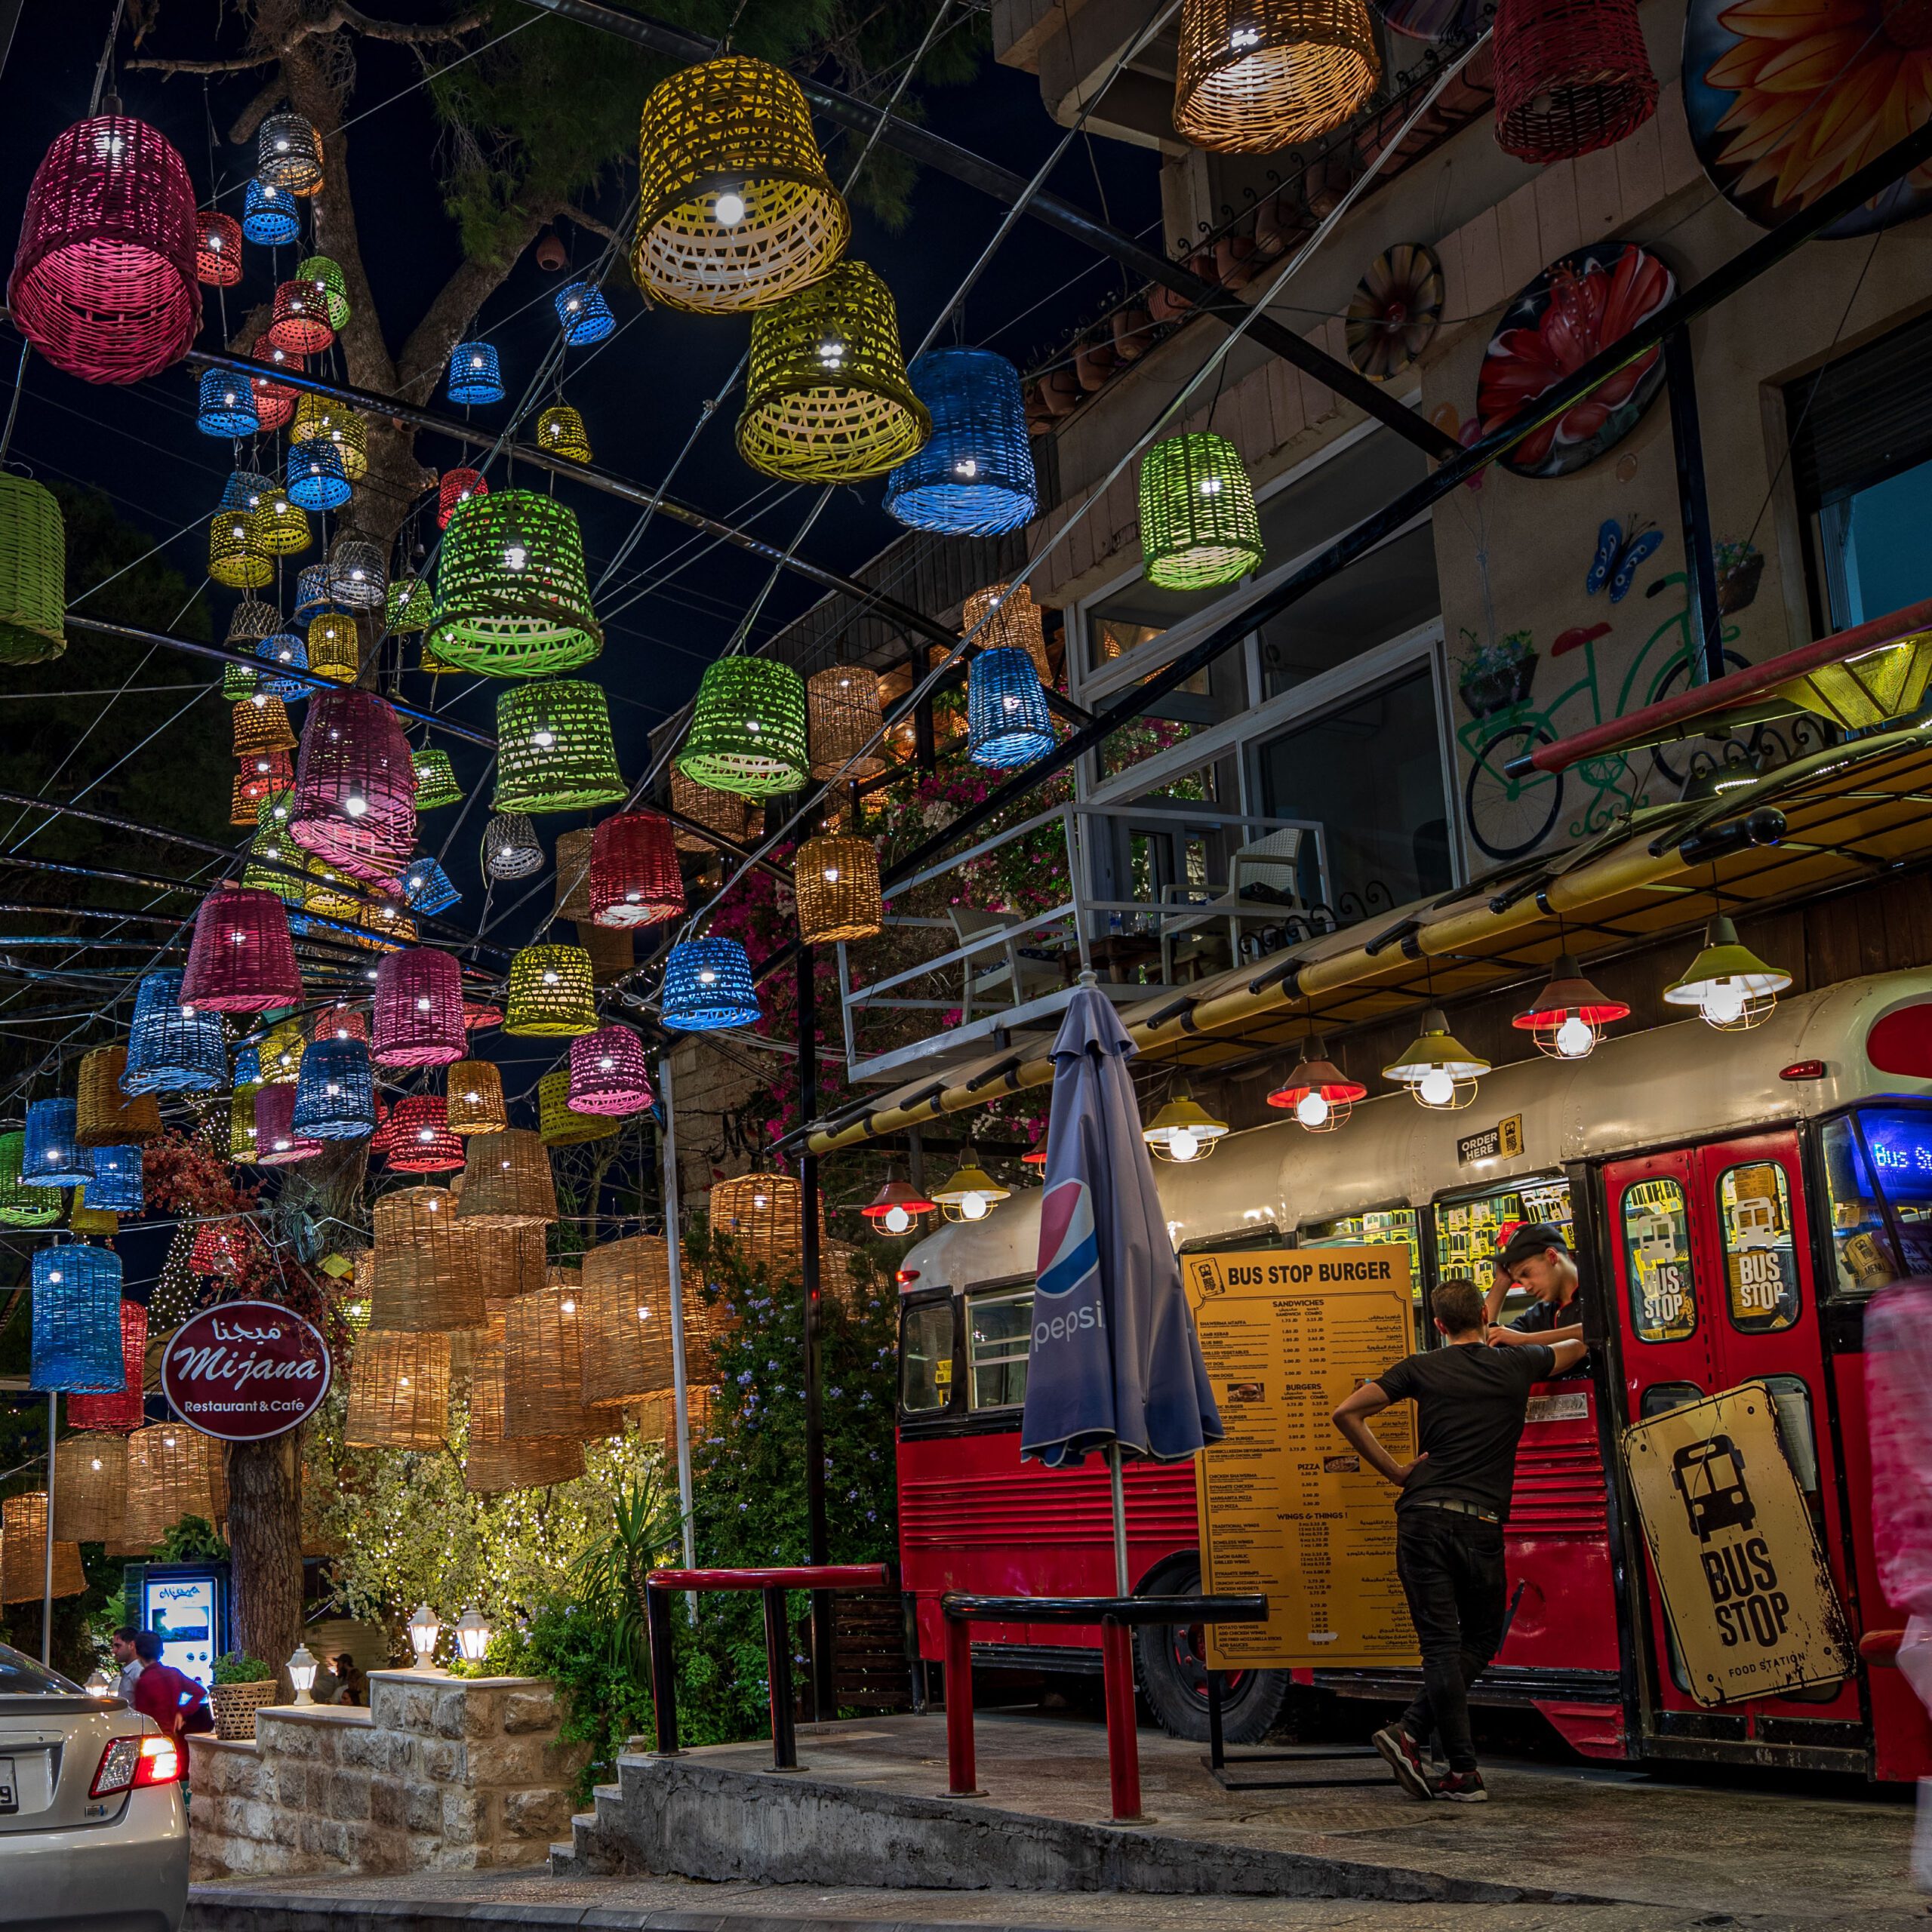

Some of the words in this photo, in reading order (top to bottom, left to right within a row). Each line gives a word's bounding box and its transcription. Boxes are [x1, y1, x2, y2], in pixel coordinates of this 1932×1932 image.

[1462, 1132, 1498, 1152] ORDER
[1466, 1143, 1494, 1160] HERE
[1874, 1143, 1909, 1167] Bus
[1228, 1267, 1263, 1285] BUS
[1268, 1264, 1313, 1284] STOP
[1318, 1261, 1392, 1282] BURGER
[1644, 1266, 1680, 1297] BUS
[1739, 1252, 1781, 1284] BUS
[1865, 1262, 1885, 1275] MENU
[1644, 1294, 1683, 1321] STOP
[1740, 1281, 1784, 1309] STOP
[211, 1318, 281, 1346] ميجنا
[1034, 1300, 1103, 1352] pepsi
[173, 1346, 321, 1391] Mijana
[1700, 1537, 1778, 1604] BUS
[1714, 1591, 1790, 1647] STOP
[1729, 1663, 1757, 1678] FOOD
[1759, 1652, 1806, 1671] STATION
